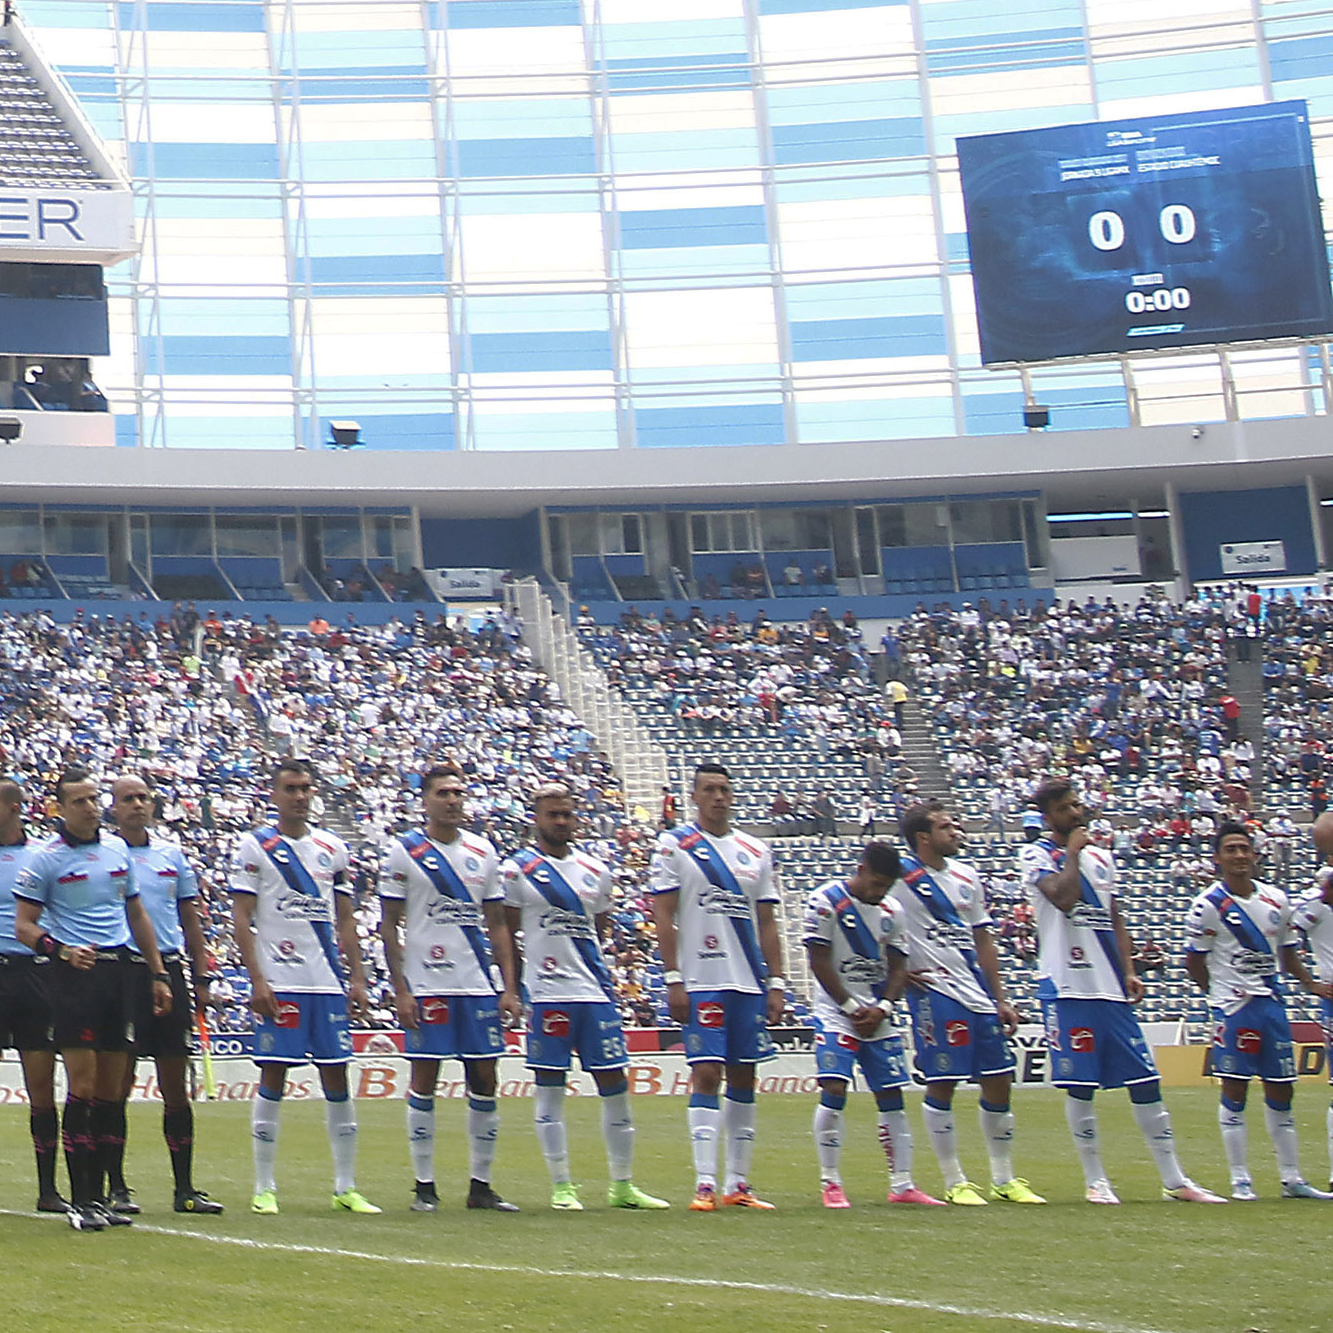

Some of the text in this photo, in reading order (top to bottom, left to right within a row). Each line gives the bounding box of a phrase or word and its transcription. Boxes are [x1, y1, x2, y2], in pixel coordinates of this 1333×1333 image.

[1088, 204, 1196, 251] 0 0
[1125, 286, 1191, 314] 0:00
[1236, 554, 1271, 564] Salida
[356, 1067, 398, 1099] B
[628, 1066, 662, 1095] B
